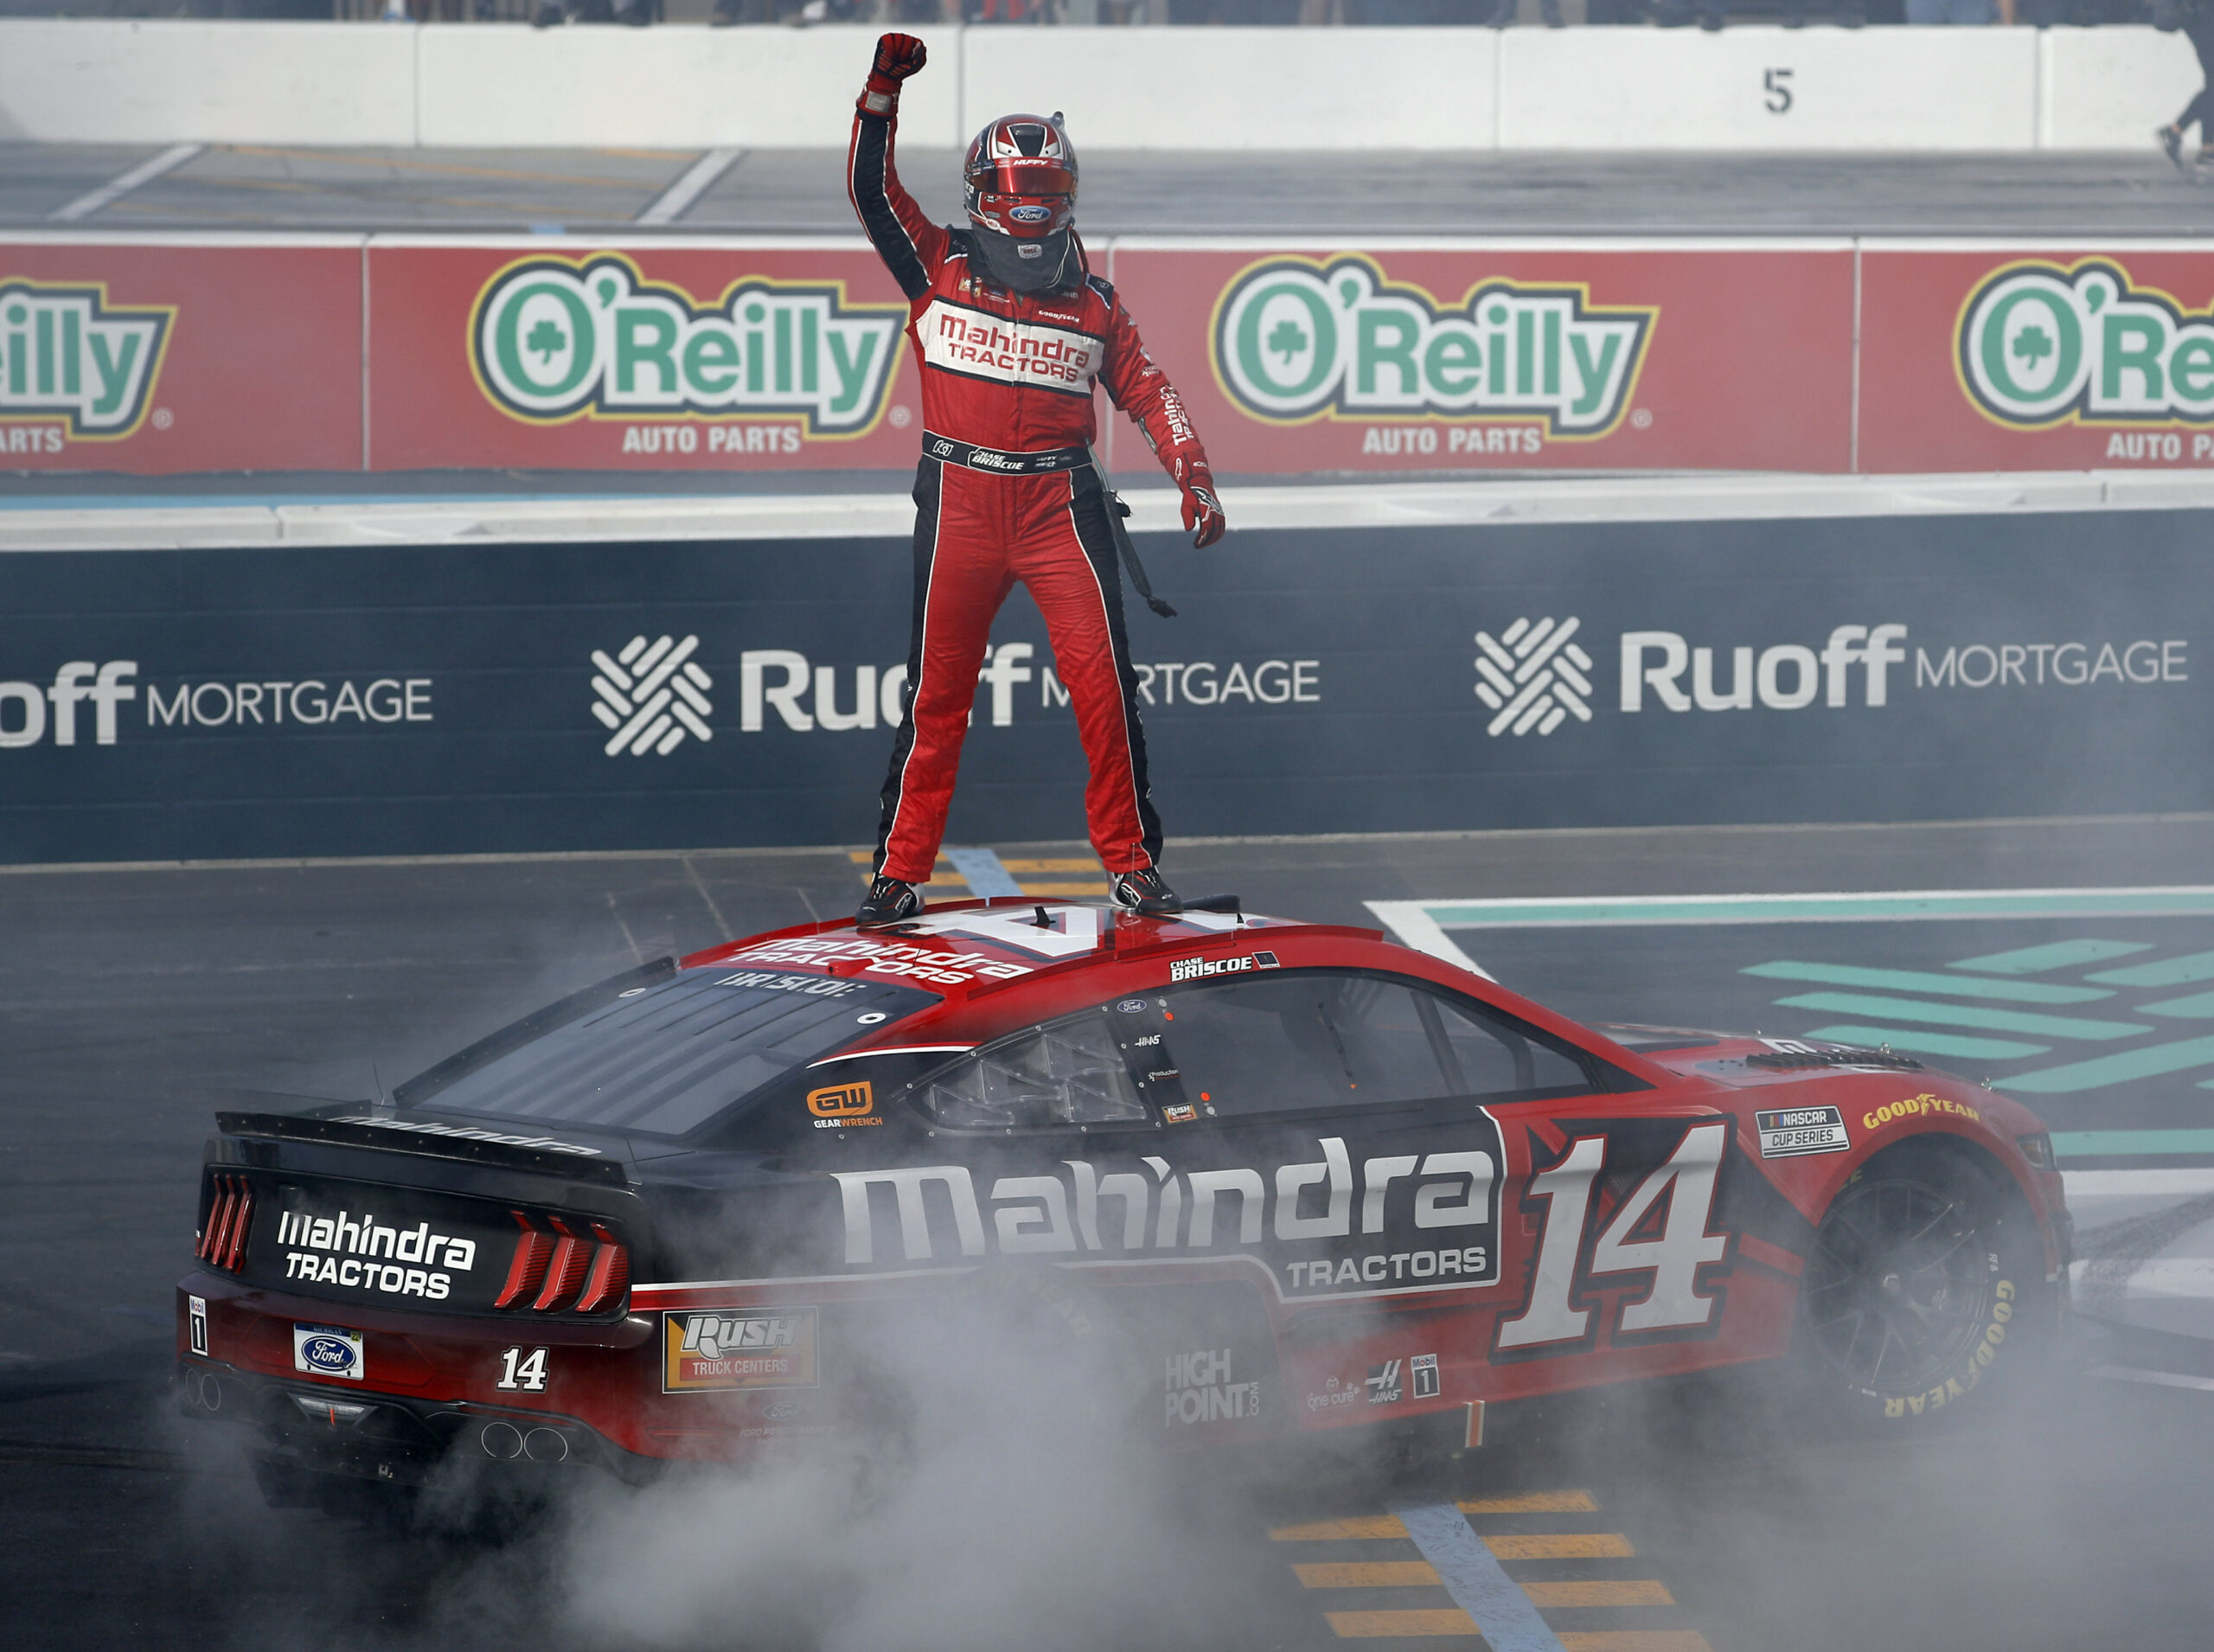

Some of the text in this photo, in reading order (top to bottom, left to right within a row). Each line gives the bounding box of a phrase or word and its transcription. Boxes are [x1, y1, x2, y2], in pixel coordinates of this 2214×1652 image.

[1765, 68, 1793, 112] 5
[1017, 208, 1043, 220] Ford
[1038, 310, 1080, 323] GOODYEAR
[0, 304, 142, 415] illy
[495, 278, 880, 413] O'Reilly
[1236, 277, 1623, 415] O'Reilly
[949, 343, 1079, 383] TRACTORS
[622, 426, 801, 454] AUTO PARTS
[1362, 426, 1542, 454] AUTO PARTS
[2106, 432, 2182, 460] AUTO
[971, 456, 1025, 471] BRISCOE
[975, 451, 1006, 463] CHASE
[1620, 624, 2189, 712] Ruoff MORTGAGE
[740, 643, 1321, 732] Ruf MRTGAGE
[147, 678, 433, 727] MORTGAGE
[1170, 957, 1203, 970] CHASE
[1171, 957, 1252, 982] BRISCOE
[814, 1117, 883, 1129] GEARWRENCH
[1782, 1111, 1827, 1126] NASCAR
[1862, 1094, 1980, 1130] GOODYEAR
[1772, 1129, 1833, 1147] CUP SERIES
[1498, 1124, 1726, 1348] 14
[285, 1252, 451, 1300] TRACTORS
[1285, 1246, 1488, 1289] TRACTORS
[190, 1298, 204, 1314] Mobil
[195, 1317, 202, 1348] 1
[312, 1341, 345, 1363] Ford
[1412, 1355, 1436, 1368] Mobil
[498, 1348, 547, 1390] 14
[693, 1359, 788, 1375] TRUCK CENTERS
[1165, 1348, 1231, 1392] HIGH
[1419, 1370, 1430, 1393] 1
[1165, 1382, 1251, 1427] POINT
